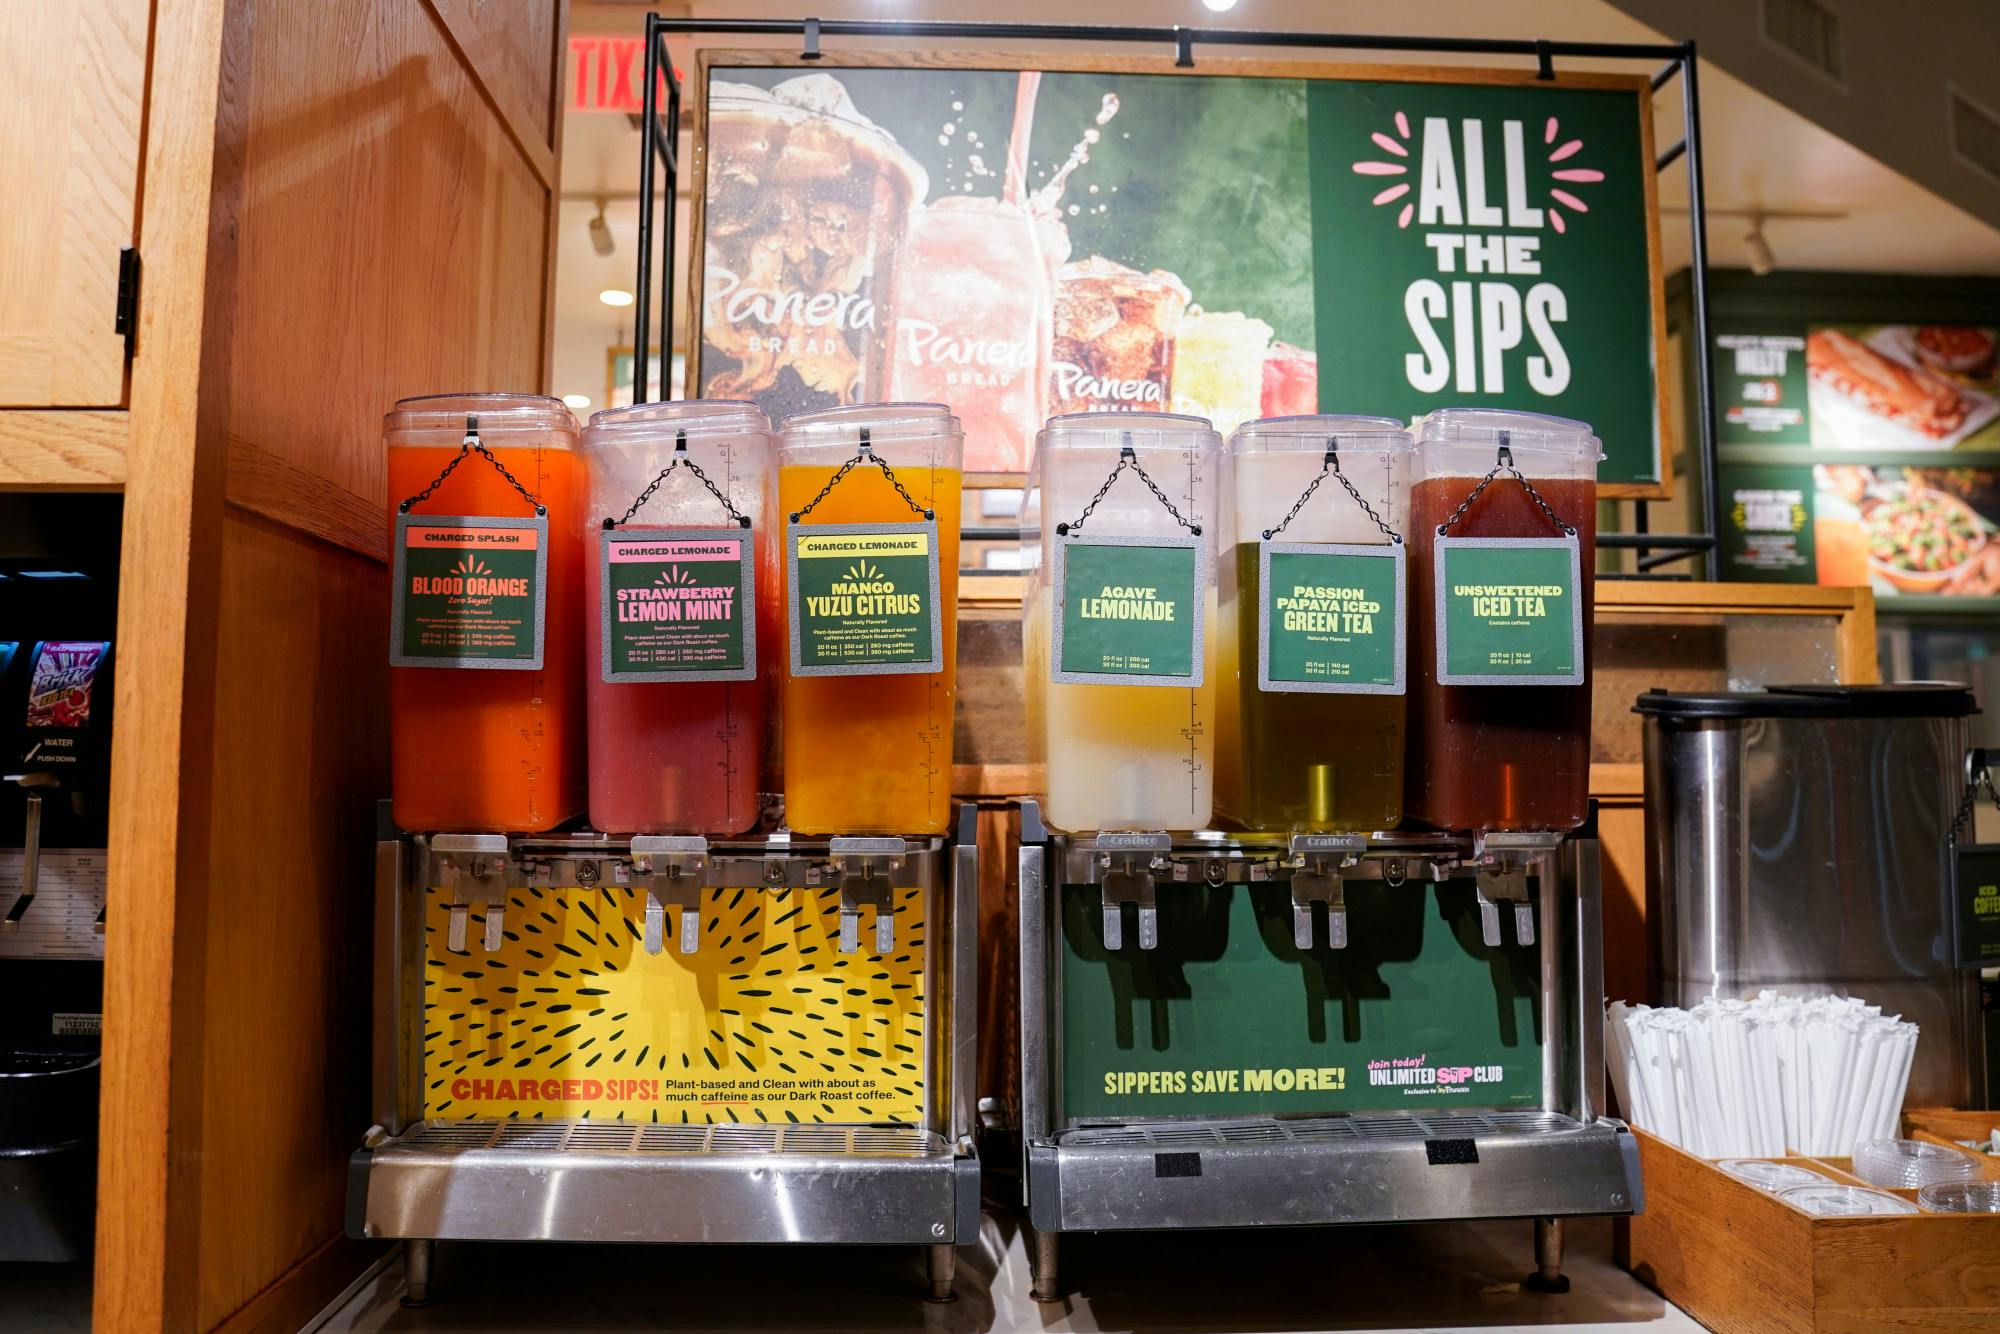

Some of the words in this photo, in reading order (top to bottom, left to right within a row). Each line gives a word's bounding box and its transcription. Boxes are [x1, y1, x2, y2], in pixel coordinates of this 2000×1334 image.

[1418, 117, 1544, 228] ALL
[1425, 233, 1541, 275] THE
[703, 265, 876, 332] Panera
[748, 335, 837, 354] BREAD
[896, 318, 1037, 369] Panera
[1404, 279, 1571, 396] SIPS
[946, 372, 1011, 387] BREAD
[1050, 360, 1161, 402] Panera
[424, 533, 475, 542] CHARGED
[477, 534, 520, 543] SPLASH
[807, 542, 857, 551] CHARGED
[859, 541, 918, 550] LEMONADE
[618, 547, 669, 556] CHARGED
[671, 546, 731, 555] LEMONADE
[412, 576, 463, 595] BLOOD
[466, 577, 529, 597] ORANGE
[616, 586, 735, 601] STRAWBERRY
[831, 581, 895, 595] MANGO
[1100, 586, 1157, 600] AGAVE
[1293, 586, 1364, 601] PASSION
[1454, 585, 1563, 597] UNSWEETENED
[618, 600, 681, 623] LEMON
[685, 599, 733, 621] MINT
[806, 595, 853, 617] YUZU
[857, 593, 921, 616] CITRUS
[1081, 598, 1176, 622] LEMONADE
[1276, 597, 1341, 612] PAPAYA
[1343, 601, 1381, 614] ICED
[1473, 597, 1511, 617] ICED
[1514, 597, 1546, 617] TEA
[1284, 611, 1338, 633] GREEN
[1342, 613, 1374, 634] TEA
[44, 738, 74, 747] WATER
[1306, 837, 1353, 847] Crathco
[1367, 1060, 1390, 1070] Join
[1392, 1053, 1426, 1068] today!
[666, 1079, 736, 1089] Plant-based
[738, 1079, 760, 1089] and
[762, 1079, 796, 1089] Clean
[799, 1079, 824, 1088] with
[827, 1078, 860, 1088] about
[862, 1080, 876, 1088] as
[1104, 1070, 1187, 1095] SIPPERS
[1191, 1070, 1239, 1093] SAVE
[1243, 1067, 1345, 1092] MORE!
[1369, 1067, 1436, 1086] UNLIMITED
[1436, 1066, 1474, 1085] SIP
[1474, 1065, 1503, 1083] CLUB
[451, 1078, 604, 1101] CHARGED
[606, 1079, 659, 1101] SIPS!
[666, 1091, 698, 1101] much
[700, 1091, 748, 1101] caffeine
[750, 1093, 765, 1101] as
[767, 1093, 786, 1101] our
[789, 1091, 817, 1101] Dark
[820, 1090, 853, 1100] Roast
[855, 1090, 896, 1100] coffee.
